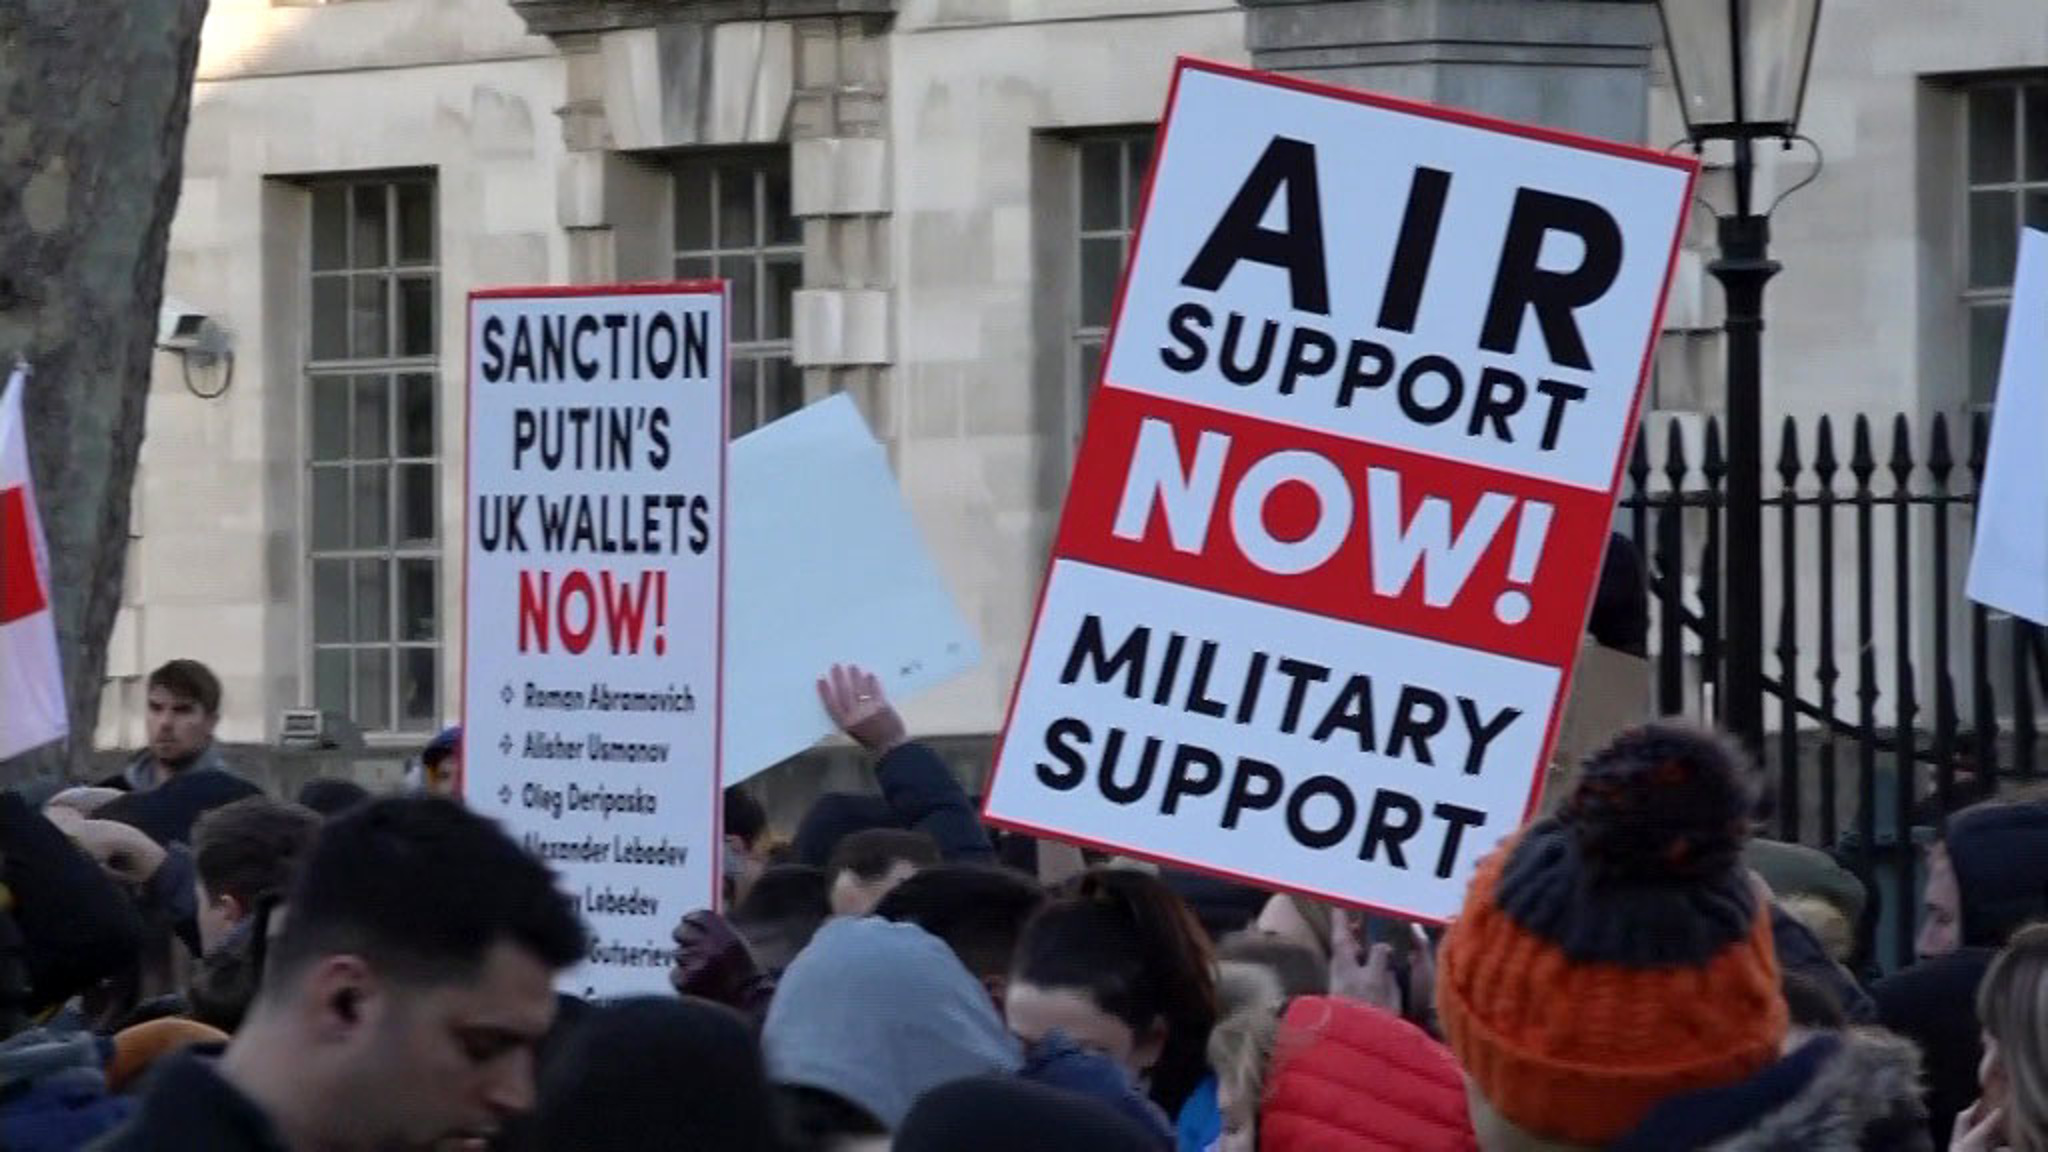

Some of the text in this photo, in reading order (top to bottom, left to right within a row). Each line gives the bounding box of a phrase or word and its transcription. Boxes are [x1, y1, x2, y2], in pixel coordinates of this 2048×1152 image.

[1180, 135, 1623, 371] AIR
[481, 310, 709, 384] SANCTION
[1160, 303, 1588, 451] SUPPORT
[513, 406, 671, 471] PUTIN'S
[479, 494, 710, 555] UK WALLETS
[1112, 418, 1554, 625] NOW!
[519, 568, 668, 655] NOW!
[525, 682, 695, 712] Roman Abramovich
[1060, 615, 1522, 780] MILITARY
[523, 732, 669, 762] Alisher Usmanov
[522, 783, 657, 820] Oleg Deripaska
[1036, 718, 1486, 878] SUPPORT
[614, 834, 688, 866] Lebedev
[587, 885, 658, 915] Lebedev
